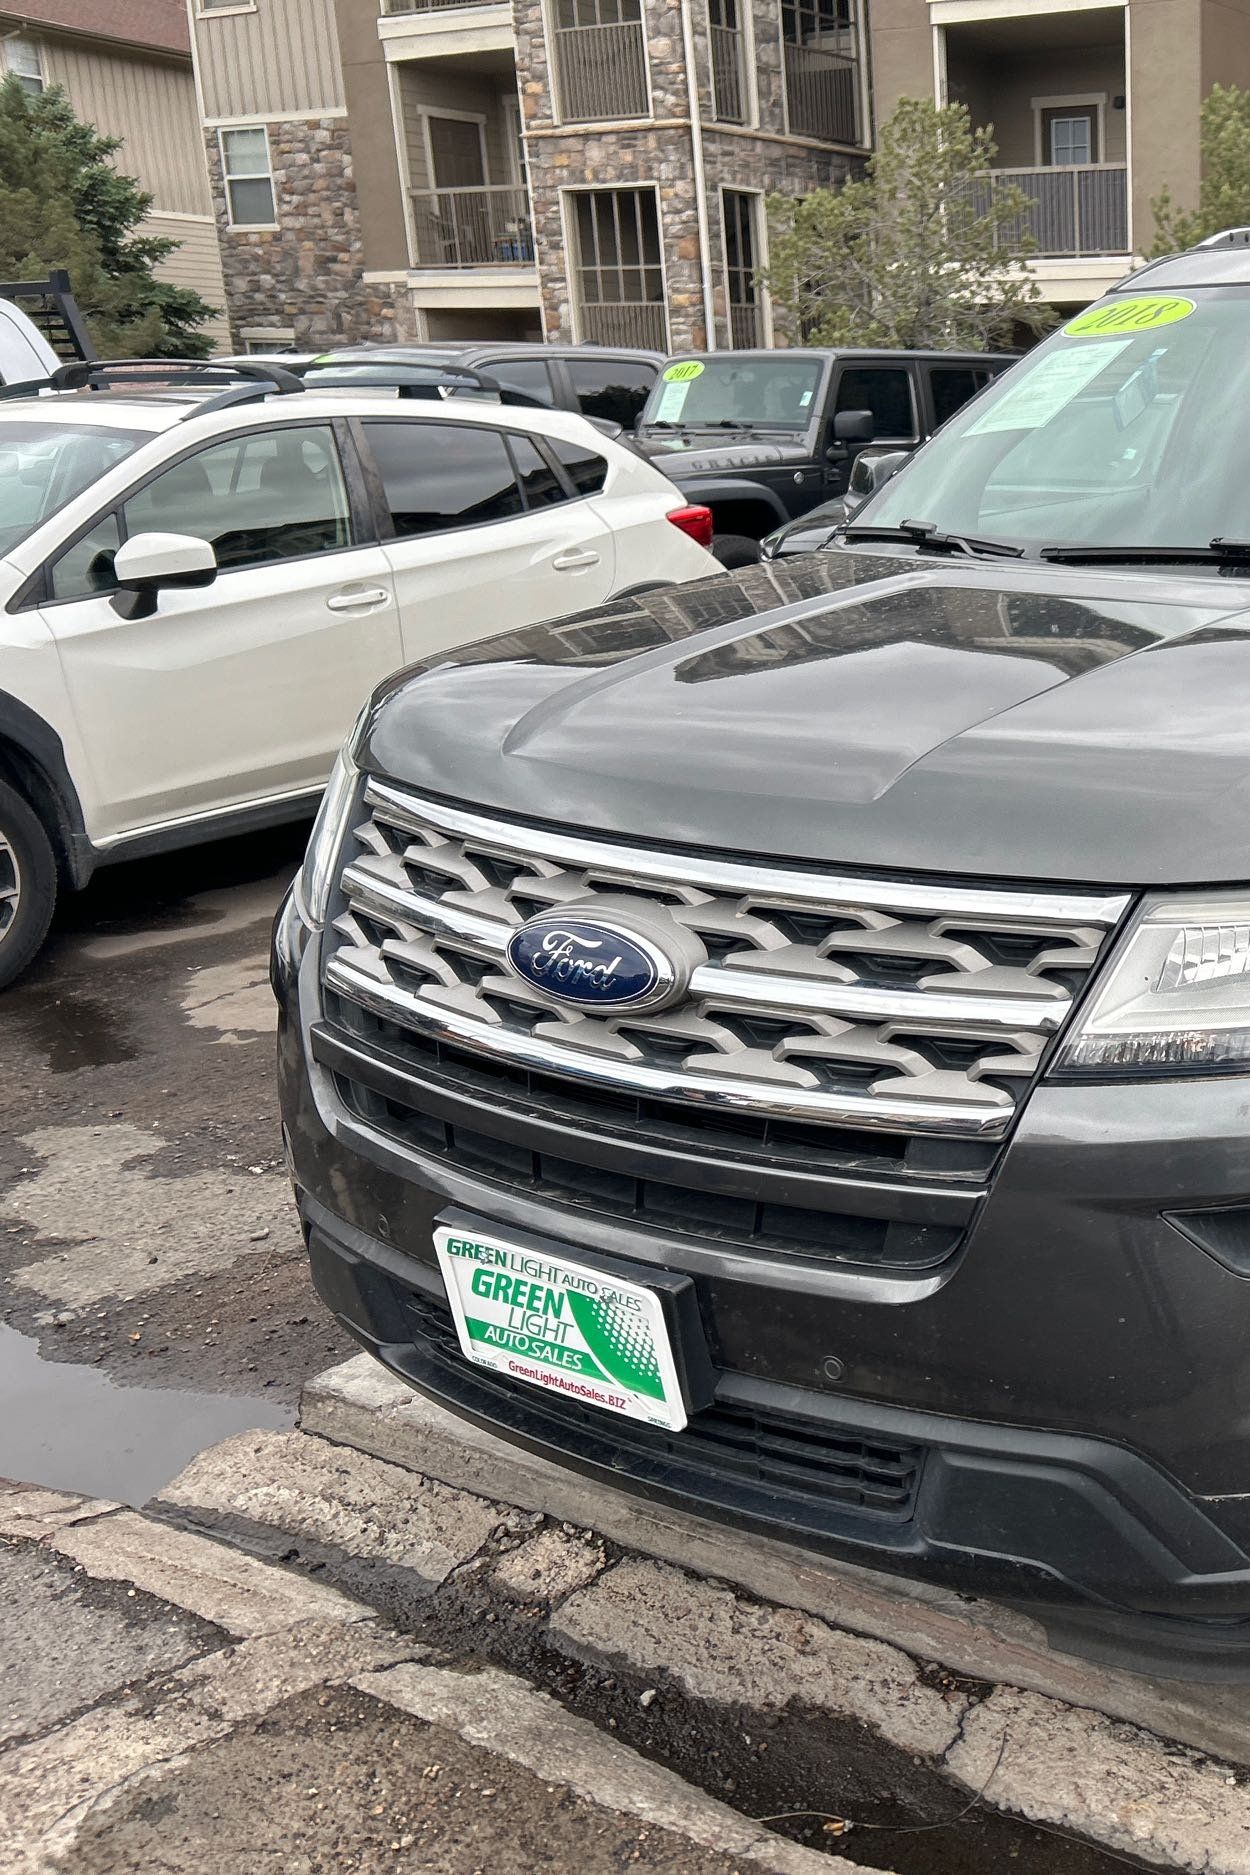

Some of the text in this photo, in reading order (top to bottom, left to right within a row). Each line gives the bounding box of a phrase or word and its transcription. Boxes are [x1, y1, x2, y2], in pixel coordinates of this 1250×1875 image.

[1074, 302, 1180, 332] 2018
[668, 364, 700, 381] 2017
[531, 930, 622, 991] Ford
[446, 1237, 642, 1312] GREEN LIGHT AUTO SALES
[471, 1267, 565, 1320] GREEN
[484, 1325, 584, 1370] AUTO SALES
[508, 1307, 575, 1344] LIGHT
[508, 1360, 627, 1410] GreenLightAutoSales.BIZ
